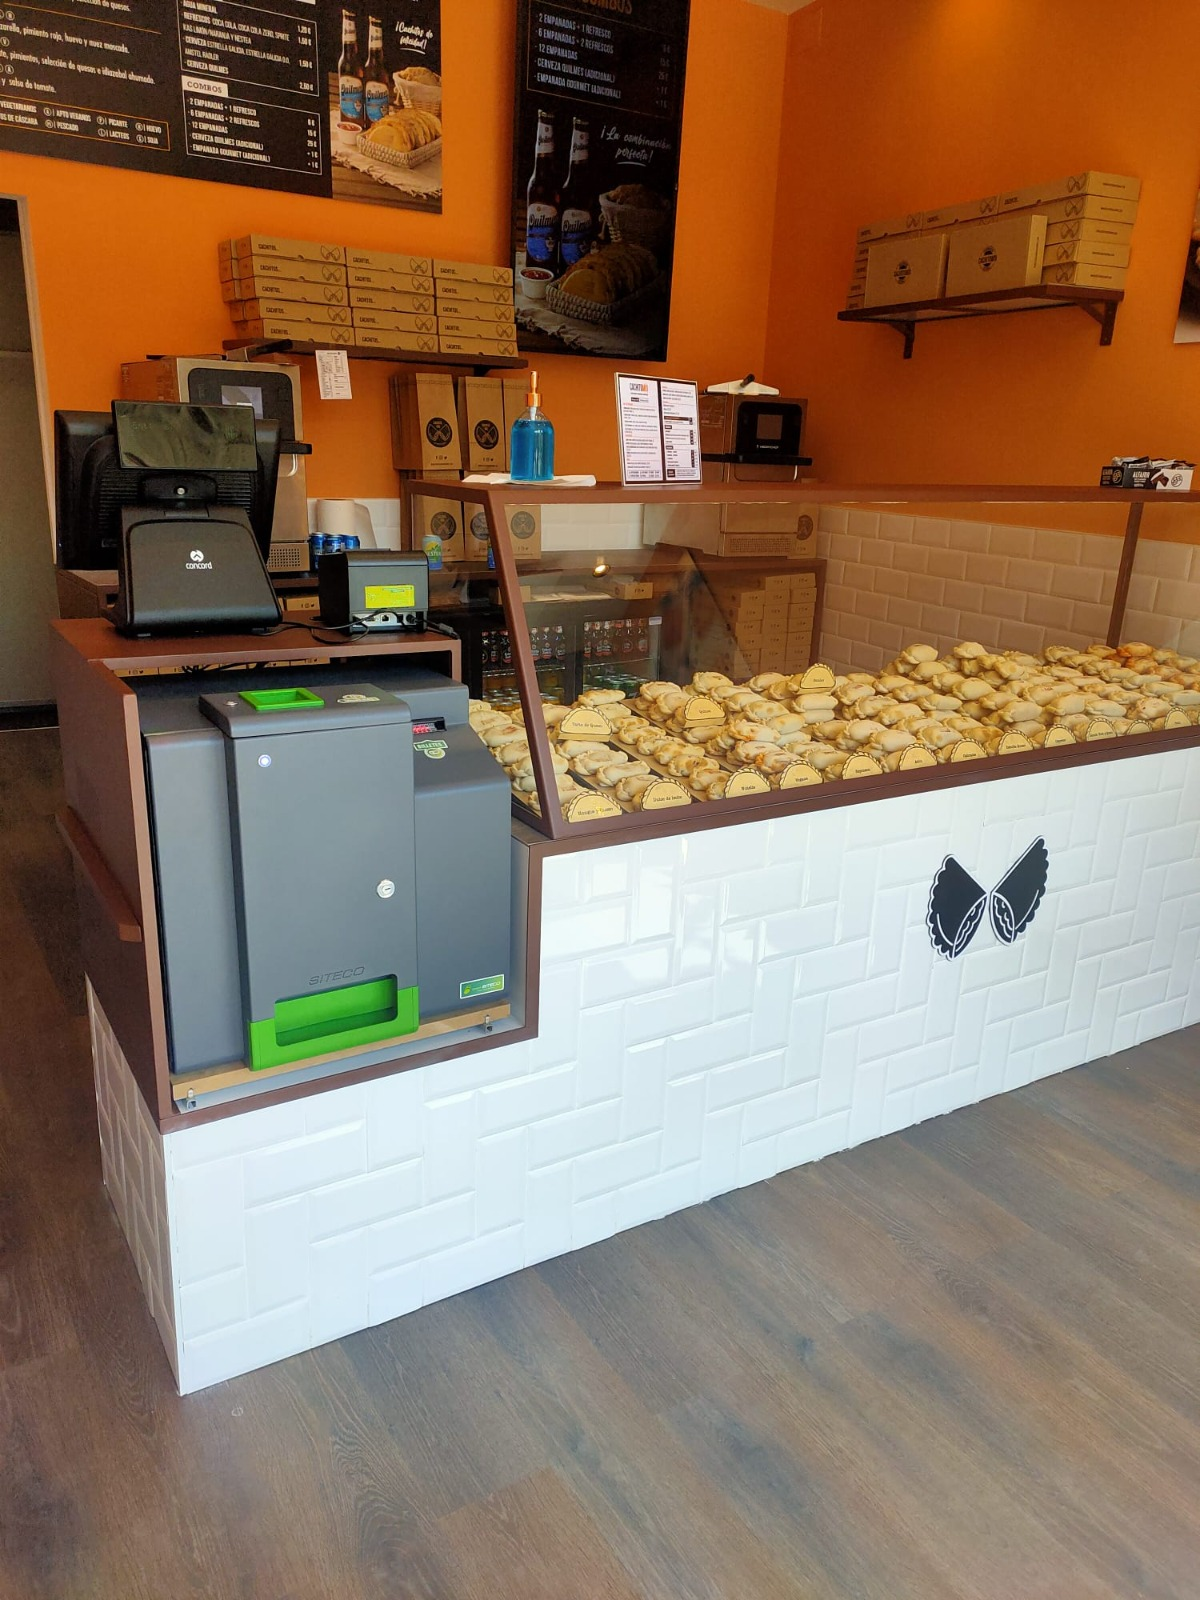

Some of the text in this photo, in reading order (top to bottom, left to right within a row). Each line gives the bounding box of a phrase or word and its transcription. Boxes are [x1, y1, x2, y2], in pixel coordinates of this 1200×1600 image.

[538, 13, 543, 23] 2
[543, 15, 576, 31] EMPANADAS
[586, 25, 612, 40] REFRESCO
[23, 26, 49, 38] pimiento
[65, 32, 83, 44] huevo
[84, 39, 88, 47] y
[538, 27, 543, 37] 6
[543, 29, 576, 46] EMPANADAS
[580, 37, 585, 48] 2
[584, 40, 614, 55] REFRESCOS
[538, 43, 578, 60] 12 EMPANADAS
[41, 56, 67, 68] selección
[69, 60, 76, 70] de
[77, 64, 96, 73] quesos
[187, 59, 208, 70] CERVEZA
[537, 58, 562, 72] CERVEZA
[561, 64, 584, 76] QUILMES
[2, 78, 6, 87] y
[9, 77, 24, 88] salsa
[25, 79, 33, 89] de
[187, 80, 223, 94] COMBOS
[537, 72, 565, 87] EMPANADA
[189, 97, 194, 106] 2
[194, 98, 224, 111] EMPANADAS
[233, 105, 257, 117] REFRESCO
[57, 121, 79, 131] PESCADO
[109, 118, 128, 128] PICANTE
[195, 110, 225, 123] EMPANADAS
[234, 117, 261, 129] REFRESCOS
[192, 121, 229, 134] 12 EMPANADAS
[191, 132, 214, 143] CERVEZA
[193, 143, 219, 155] EMPANADA
[185, 561, 213, 570] concord
[308, 966, 366, 986] SITECO
